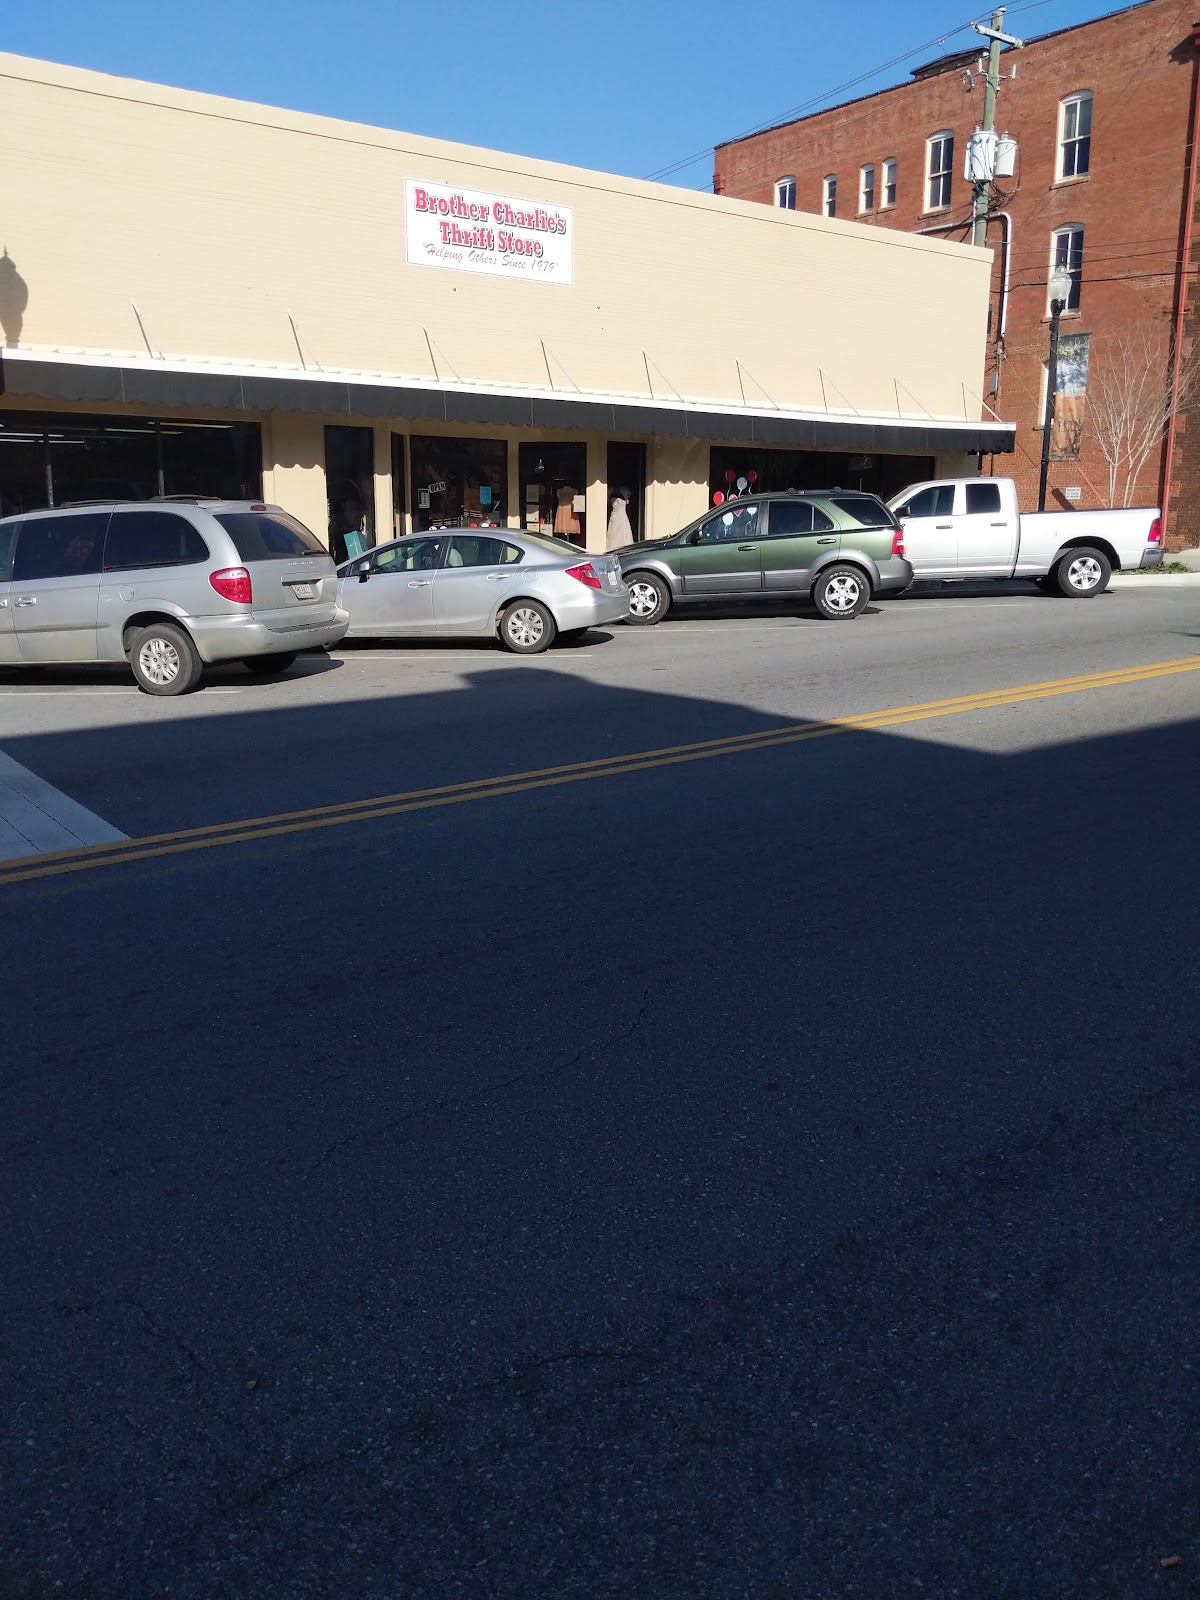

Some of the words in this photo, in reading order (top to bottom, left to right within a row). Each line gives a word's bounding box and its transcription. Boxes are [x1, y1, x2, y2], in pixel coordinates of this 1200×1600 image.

[414, 188, 489, 222] Brother
[493, 202, 566, 235] Charlie's
[439, 221, 495, 250] Thrift
[498, 229, 544, 257] Store
[468, 249, 497, 265] Others
[501, 255, 526, 269] Since
[429, 482, 446, 493] OPEN
